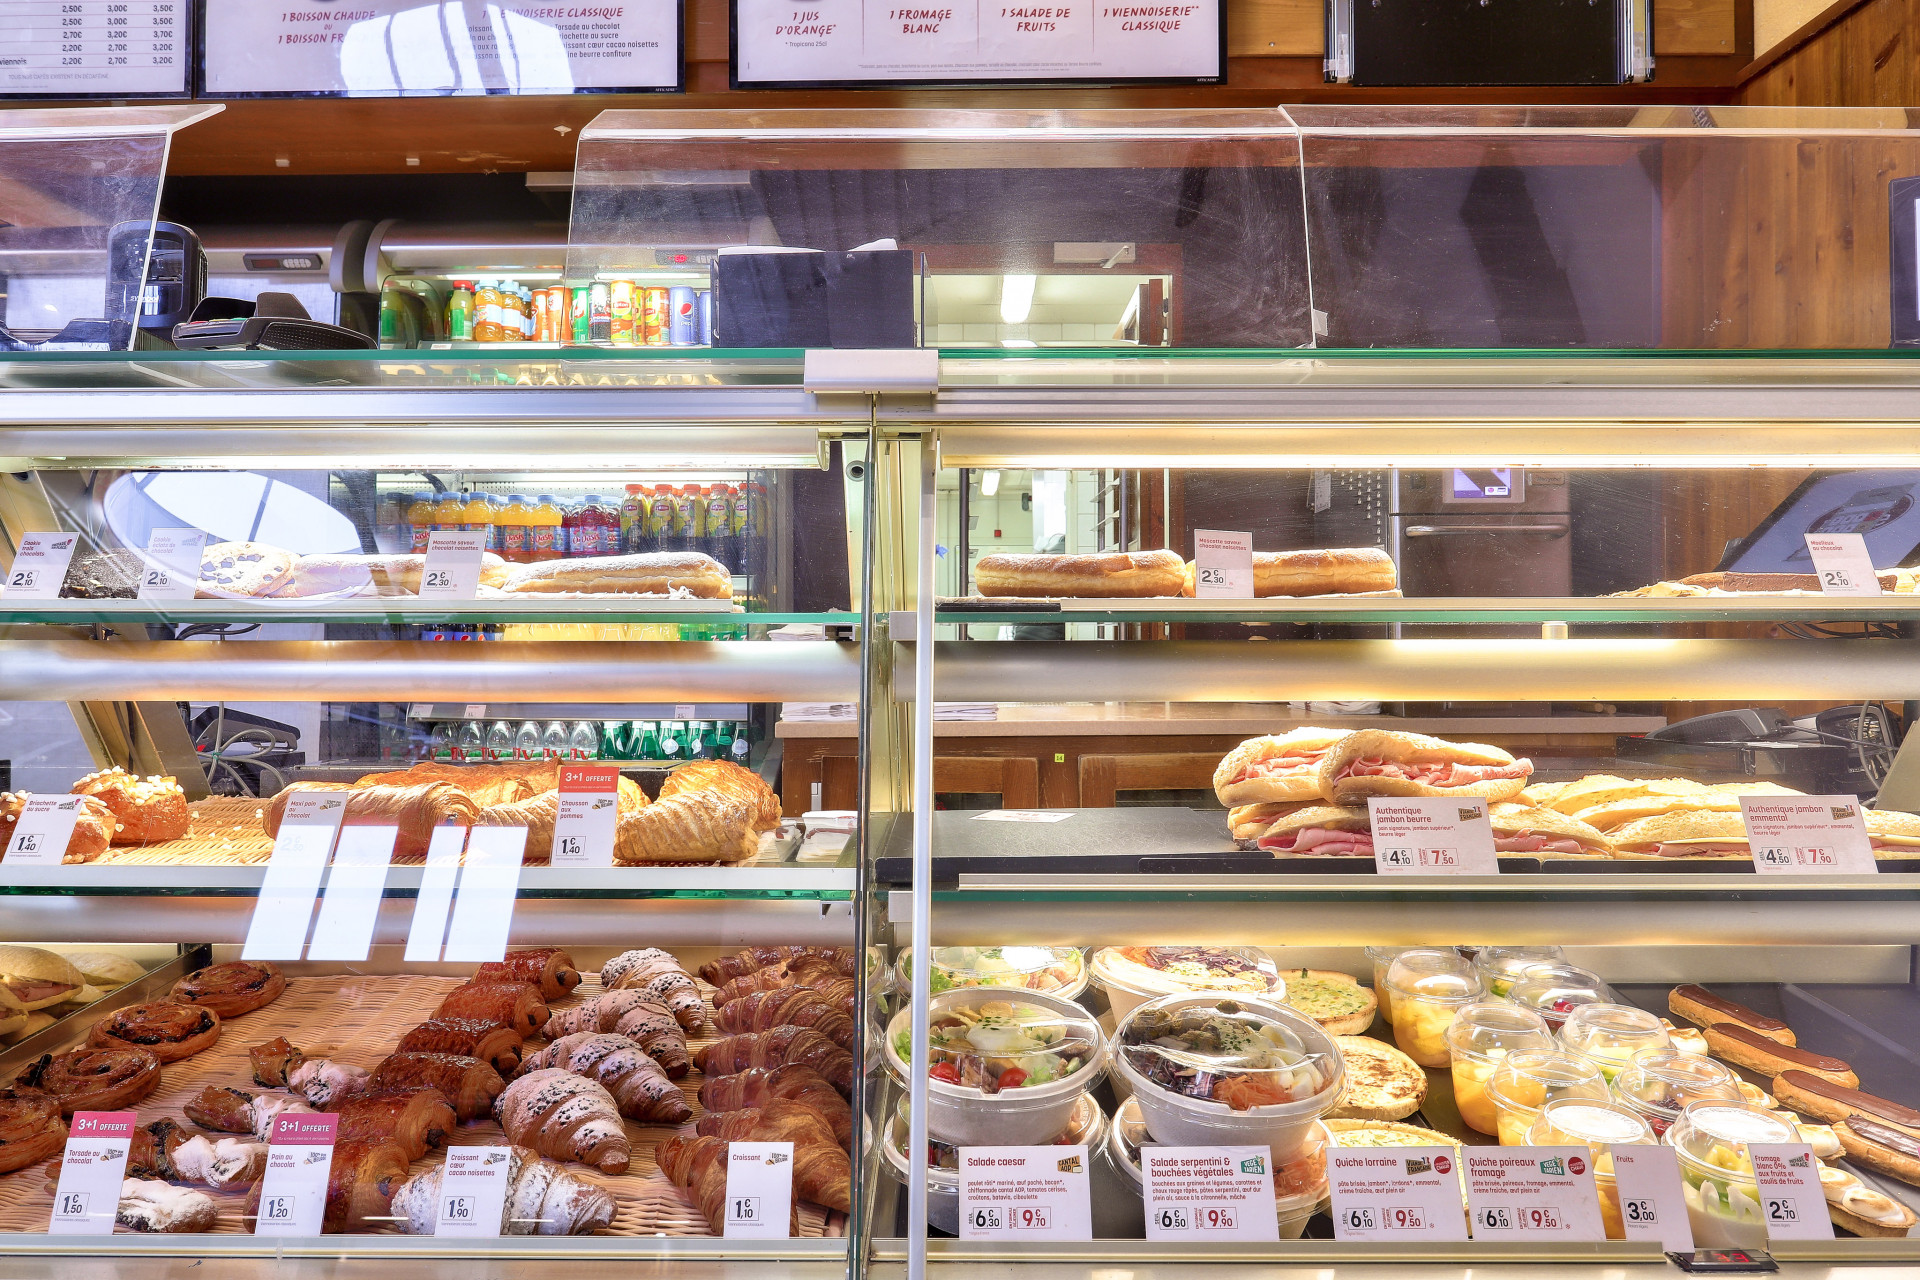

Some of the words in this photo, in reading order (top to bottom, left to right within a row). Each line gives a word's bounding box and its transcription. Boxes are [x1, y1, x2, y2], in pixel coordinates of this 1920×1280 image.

[108, 5, 128, 13] 3,00€
[567, 7, 624, 20] CLASSIQUE
[1001, 9, 1006, 18] 1
[1010, 8, 1052, 18] SALADE
[1056, 8, 1071, 18] DE
[1104, 8, 1108, 17] 1
[282, 14, 287, 22] 1
[290, 12, 331, 22] BOISSON
[334, 11, 375, 21] CHAUDE
[793, 12, 798, 21] 1
[800, 12, 820, 24] JUS
[890, 11, 895, 20] 1
[898, 9, 952, 21] FROMAGE
[62, 18, 83, 26] 2,50€
[107, 18, 128, 26] 3,00€
[1017, 22, 1056, 32] FRUITS
[1122, 20, 1181, 34] CLASSIQUE
[903, 24, 940, 34] BLANC
[108, 31, 128, 39] 3,20€
[278, 35, 283, 44] 1
[286, 34, 327, 44] BOISSON
[108, 44, 128, 52] 2,70€
[602, 50, 632, 58] confiture
[108, 57, 128, 65] 2,70€
[505, 533, 525, 543] Oasis
[535, 534, 554, 543] Oasis
[566, 772, 583, 782] 3+1
[1376, 807, 1422, 816] Authentique
[1748, 805, 1794, 816] Authentique
[1794, 805, 1824, 815] jambon
[1376, 816, 1405, 825] jambon
[1750, 814, 1788, 822] emmental
[78, 1119, 98, 1131] 3+1
[280, 1121, 299, 1132] 3+1
[968, 1157, 996, 1167] Salade
[998, 1158, 1026, 1167] caesar
[1151, 1158, 1179, 1167] Salade
[1181, 1157, 1222, 1168] serpentini
[1224, 1157, 1230, 1166] &
[1336, 1158, 1364, 1168] Quiche
[1365, 1157, 1397, 1167] lorraine
[1469, 1157, 1498, 1167] Quiche
[1500, 1157, 1535, 1168] poireaux
[1755, 1156, 1780, 1165] Fromage
[1152, 1168, 1192, 1177] bouchées
[1193, 1167, 1234, 1178] végétales
[1471, 1168, 1506, 1179] fromage
